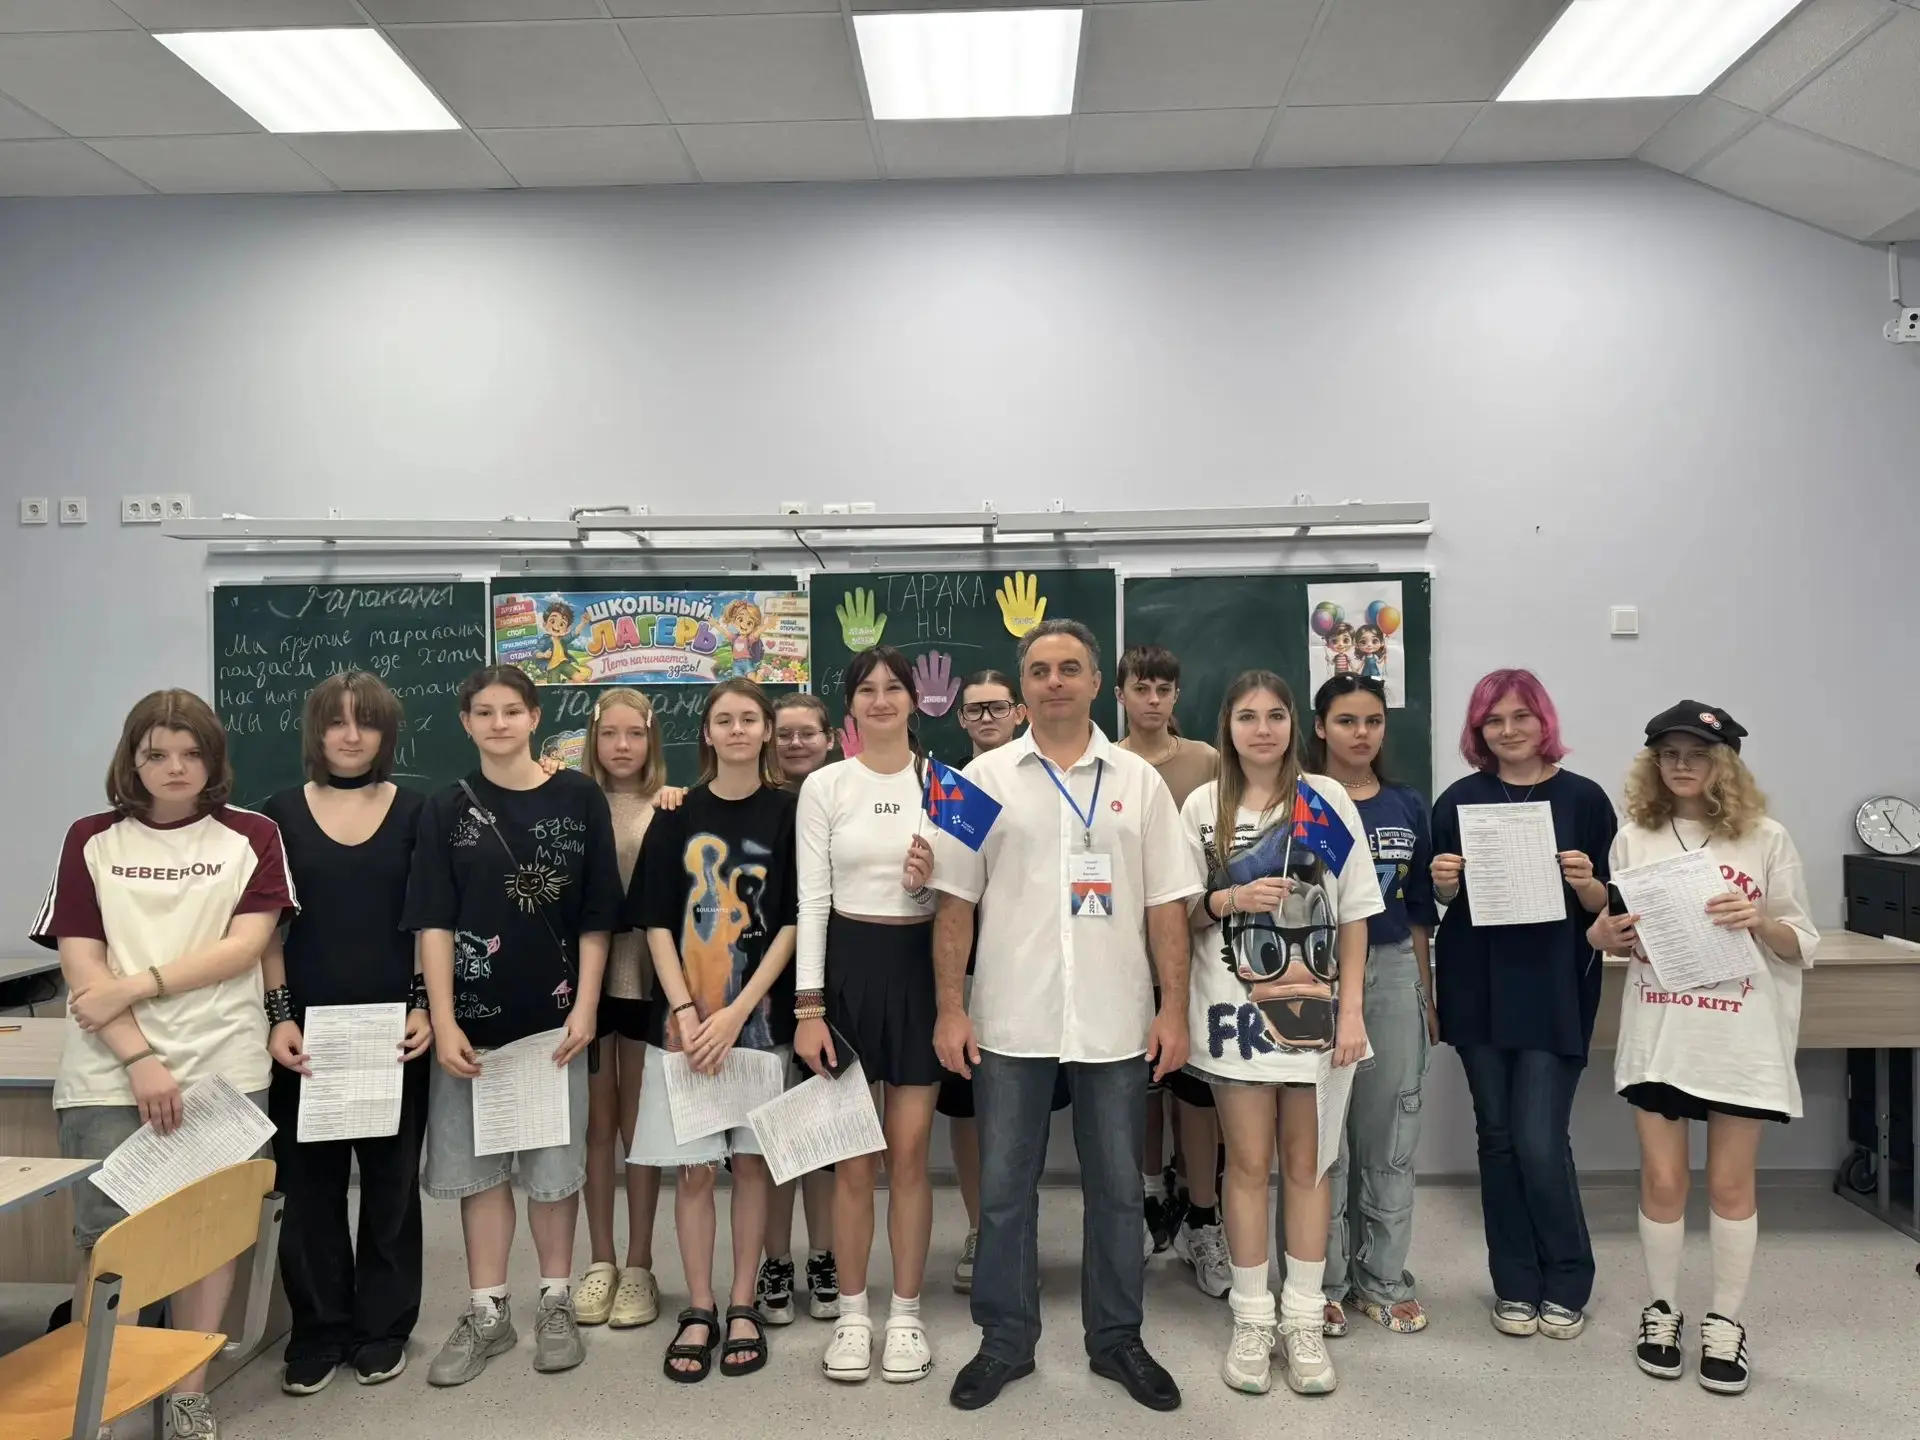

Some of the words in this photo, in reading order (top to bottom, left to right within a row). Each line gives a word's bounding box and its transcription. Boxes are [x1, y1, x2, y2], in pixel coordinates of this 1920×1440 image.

[878, 574, 986, 612] ТАРАКА
[586, 595, 713, 622] ШКОЛЬНЫЙ
[917, 606, 952, 638] НЫ
[506, 628, 526, 637] СПОРТ
[586, 614, 718, 657] ЛАГЕРЬ
[510, 651, 533, 660] ОТДЫХ
[601, 658, 628, 674] Лето
[630, 654, 688, 666] начинается
[667, 659, 701, 679] здесь!
[875, 803, 901, 815] GAP
